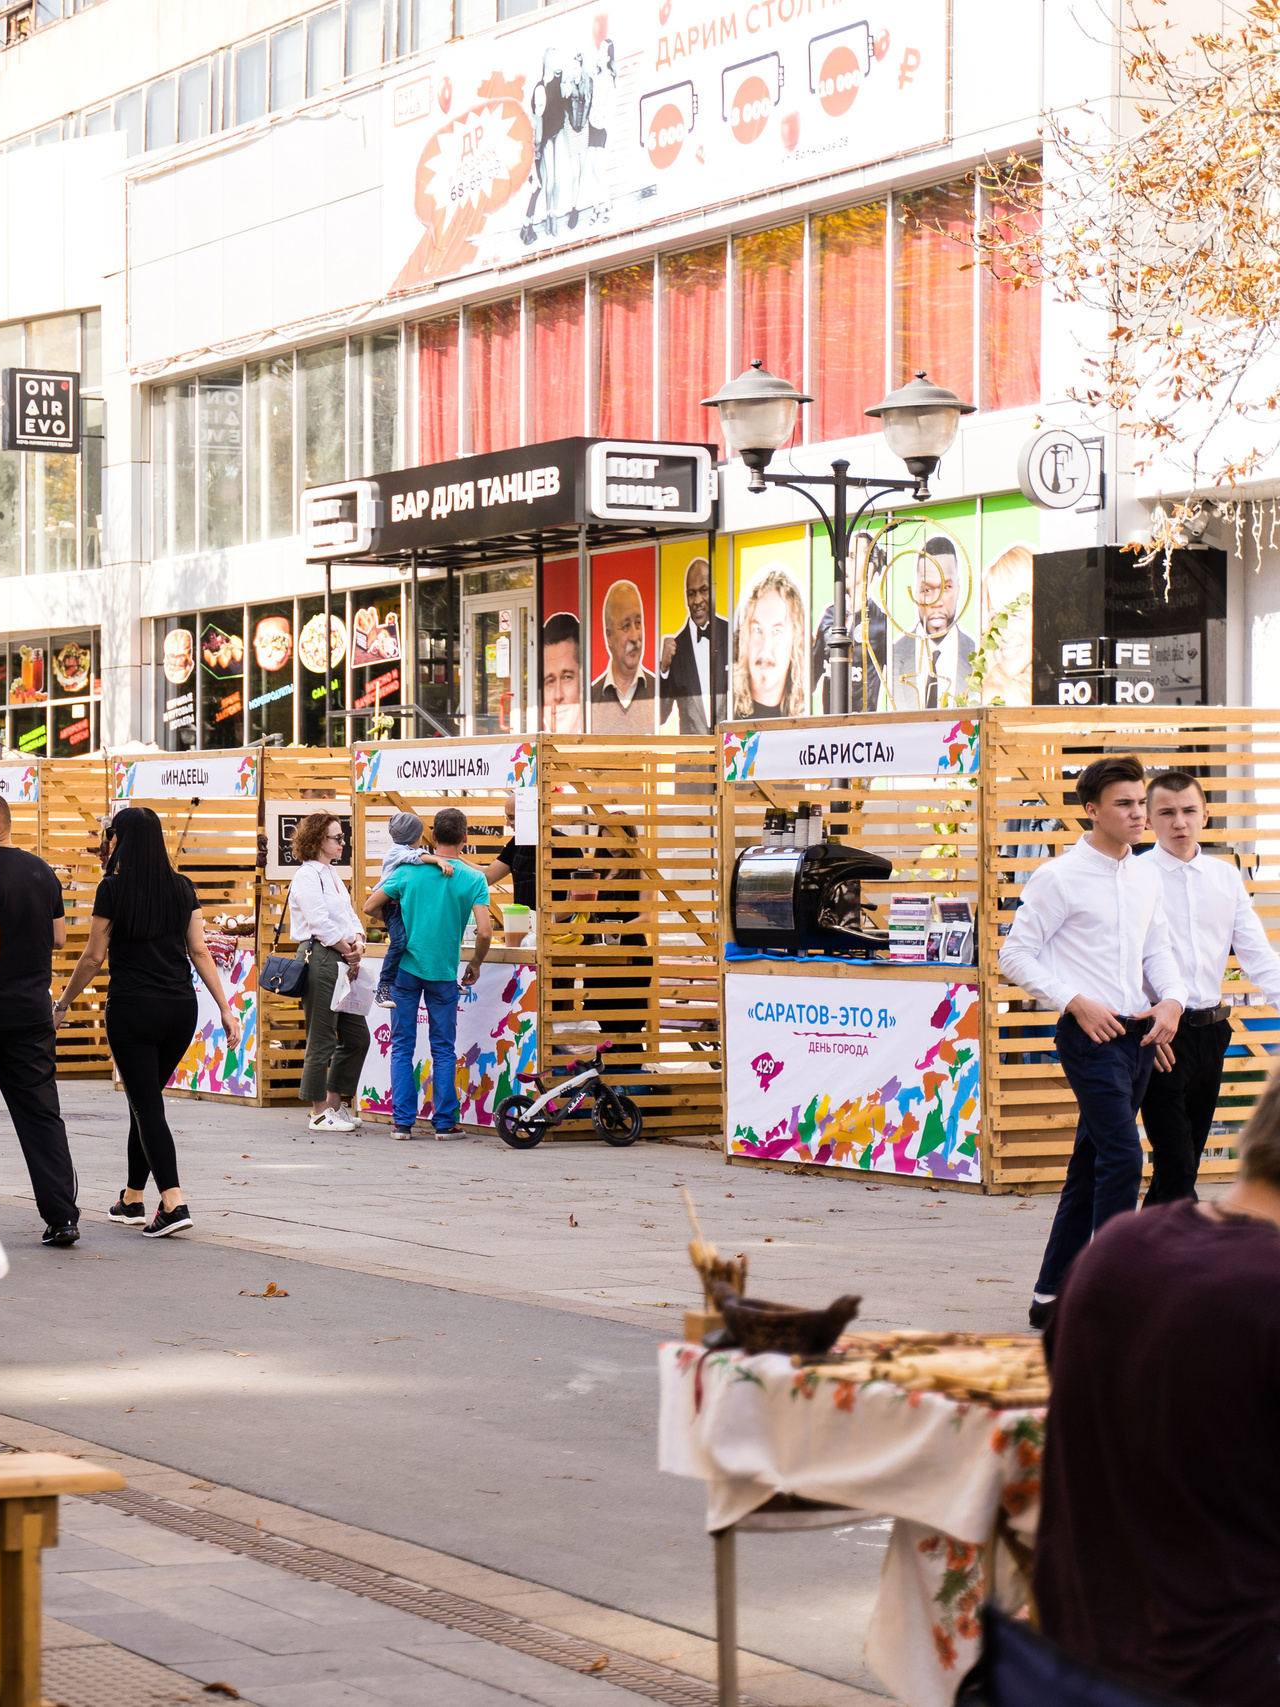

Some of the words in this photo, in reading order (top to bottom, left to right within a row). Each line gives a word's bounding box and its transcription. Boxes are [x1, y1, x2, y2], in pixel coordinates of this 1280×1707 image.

[655, 12, 737, 72] ДАРИМ
[836, 70, 861, 92] 000
[742, 97, 770, 123] 000
[460, 125, 484, 162] ДР
[659, 123, 685, 148] 000
[25, 380, 55, 396] ON
[25, 399, 63, 416] AIR
[25, 418, 66, 435] EVO
[390, 488, 430, 523] БАР
[431, 481, 474, 521] ДЛЯ
[477, 465, 560, 509] ТАНЦЕВ
[1062, 642, 1092, 667] FE
[1115, 643, 1151, 666] FE
[1058, 681, 1092, 705] RO
[1115, 681, 1155, 705] RO
[798, 742, 894, 767] «БАРИСТА»
[160, 768, 210, 788] «ИНДЕЕЦ»
[395, 758, 491, 780] «СМУЗИШНАЯ»
[876, 1008, 897, 1029] Я»
[377, 1029, 391, 1043] 429
[807, 1041, 833, 1054] ДЕНЬ
[834, 1042, 869, 1057] ГОРОДА
[756, 1058, 775, 1075] 429
